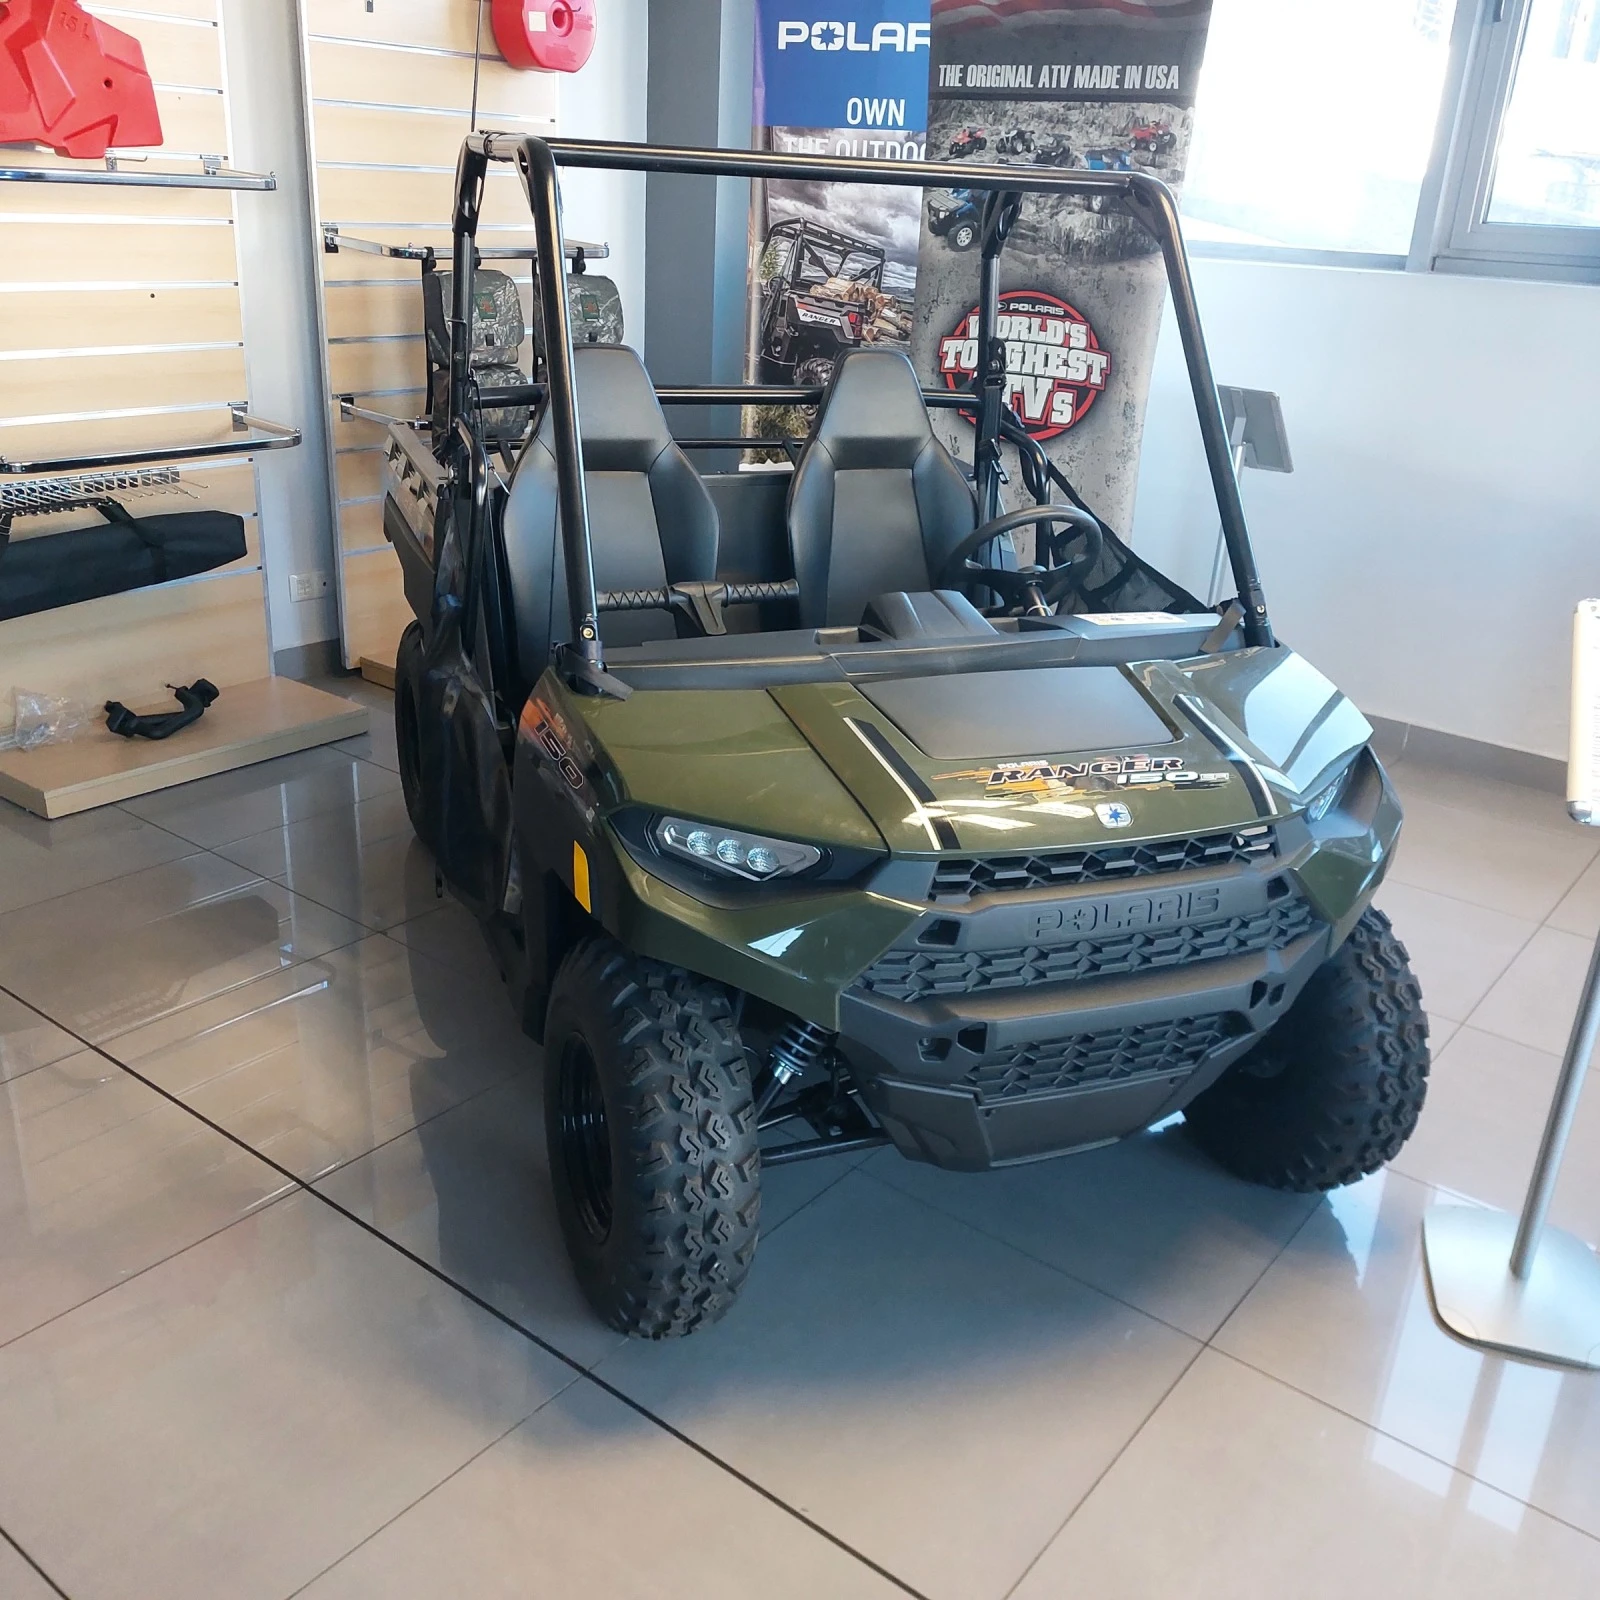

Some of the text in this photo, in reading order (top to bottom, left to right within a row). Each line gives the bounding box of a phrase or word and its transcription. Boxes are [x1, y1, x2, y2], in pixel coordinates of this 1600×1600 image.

[777, 21, 931, 53] POLAR
[939, 64, 1179, 90] THE ORIGINAL ATV MADE IN USA
[846, 97, 906, 127] OWN
[782, 136, 829, 155] THE
[801, 312, 837, 325] RANGER
[1009, 302, 1065, 316] POLARIS
[942, 339, 1108, 385] TOGHEST
[533, 719, 585, 790] 150
[987, 756, 1184, 785] RANGER
[1116, 770, 1199, 785] 150
[1034, 887, 1220, 938] POLARIS
